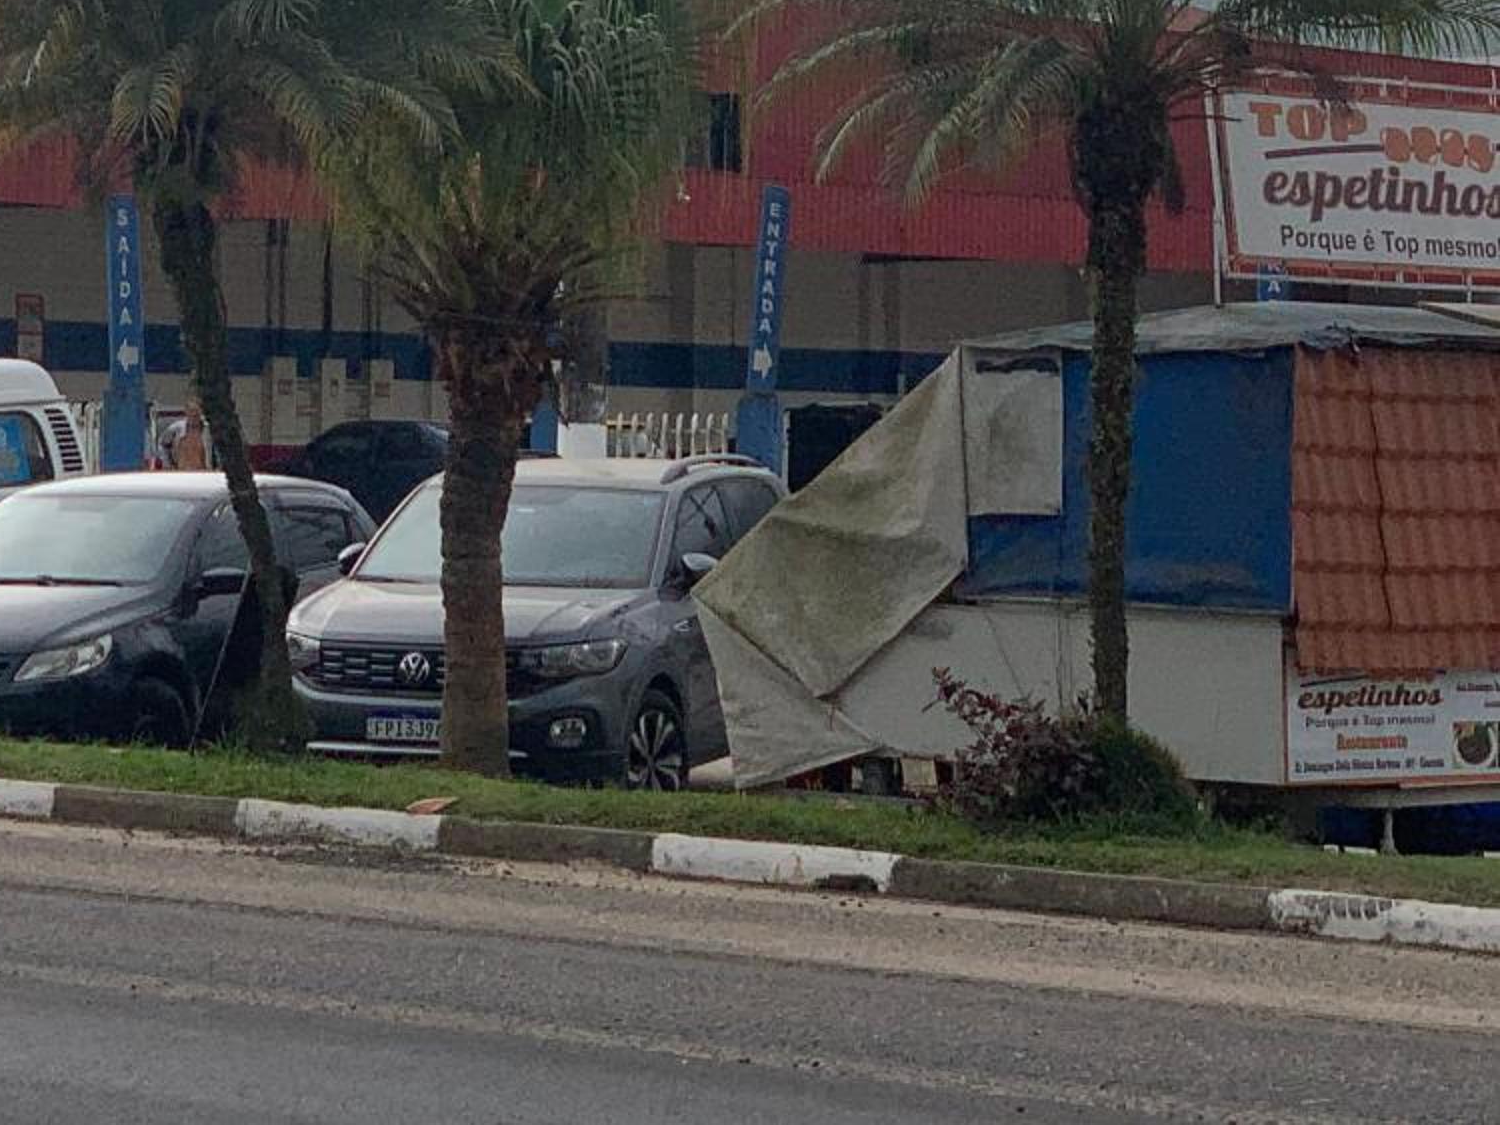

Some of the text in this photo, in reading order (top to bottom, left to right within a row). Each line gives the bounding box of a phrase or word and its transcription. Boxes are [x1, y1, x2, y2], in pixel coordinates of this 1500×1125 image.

[1250, 101, 1367, 142] TOP
[1263, 166, 1500, 222] espetinhos
[1281, 225, 1356, 256] Porque
[1381, 230, 1419, 258] Top
[758, 203, 781, 333] ENTRADA
[1297, 684, 1443, 715] espetinhos
